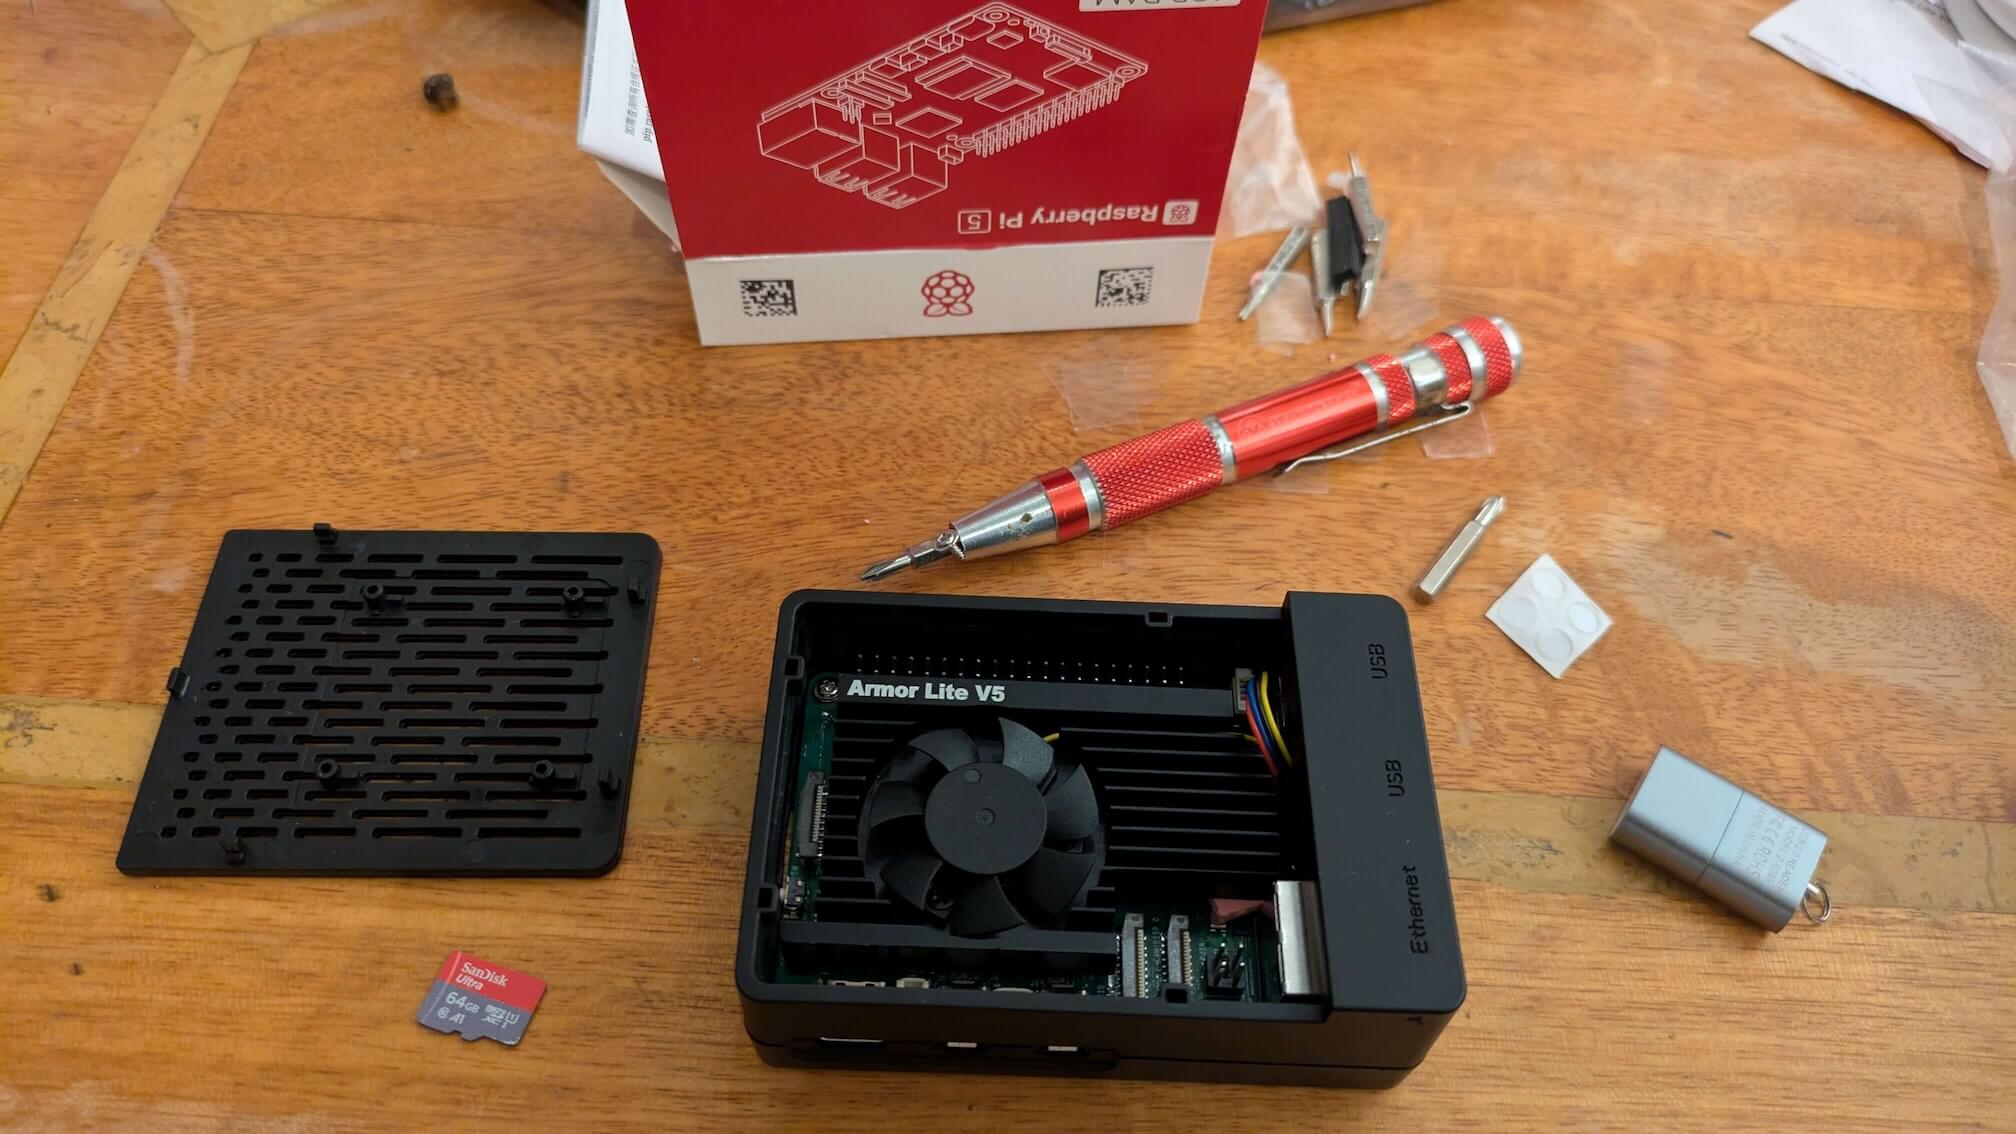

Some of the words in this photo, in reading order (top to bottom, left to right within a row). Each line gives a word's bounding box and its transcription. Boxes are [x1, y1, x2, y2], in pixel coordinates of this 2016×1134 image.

[967, 214, 982, 230] 5
[1000, 212, 1024, 229] Pi
[1031, 204, 1159, 226] Raspberry
[1371, 643, 1388, 680] USB
[847, 679, 920, 699] Armor
[925, 683, 969, 700] Lite
[975, 684, 1005, 702] V5
[1385, 759, 1405, 797] USB
[1402, 865, 1428, 954] Ethernet
[456, 974, 484, 990] Ultra
[461, 962, 508, 987] SanDisk
[446, 992, 480, 1013] 64GB
